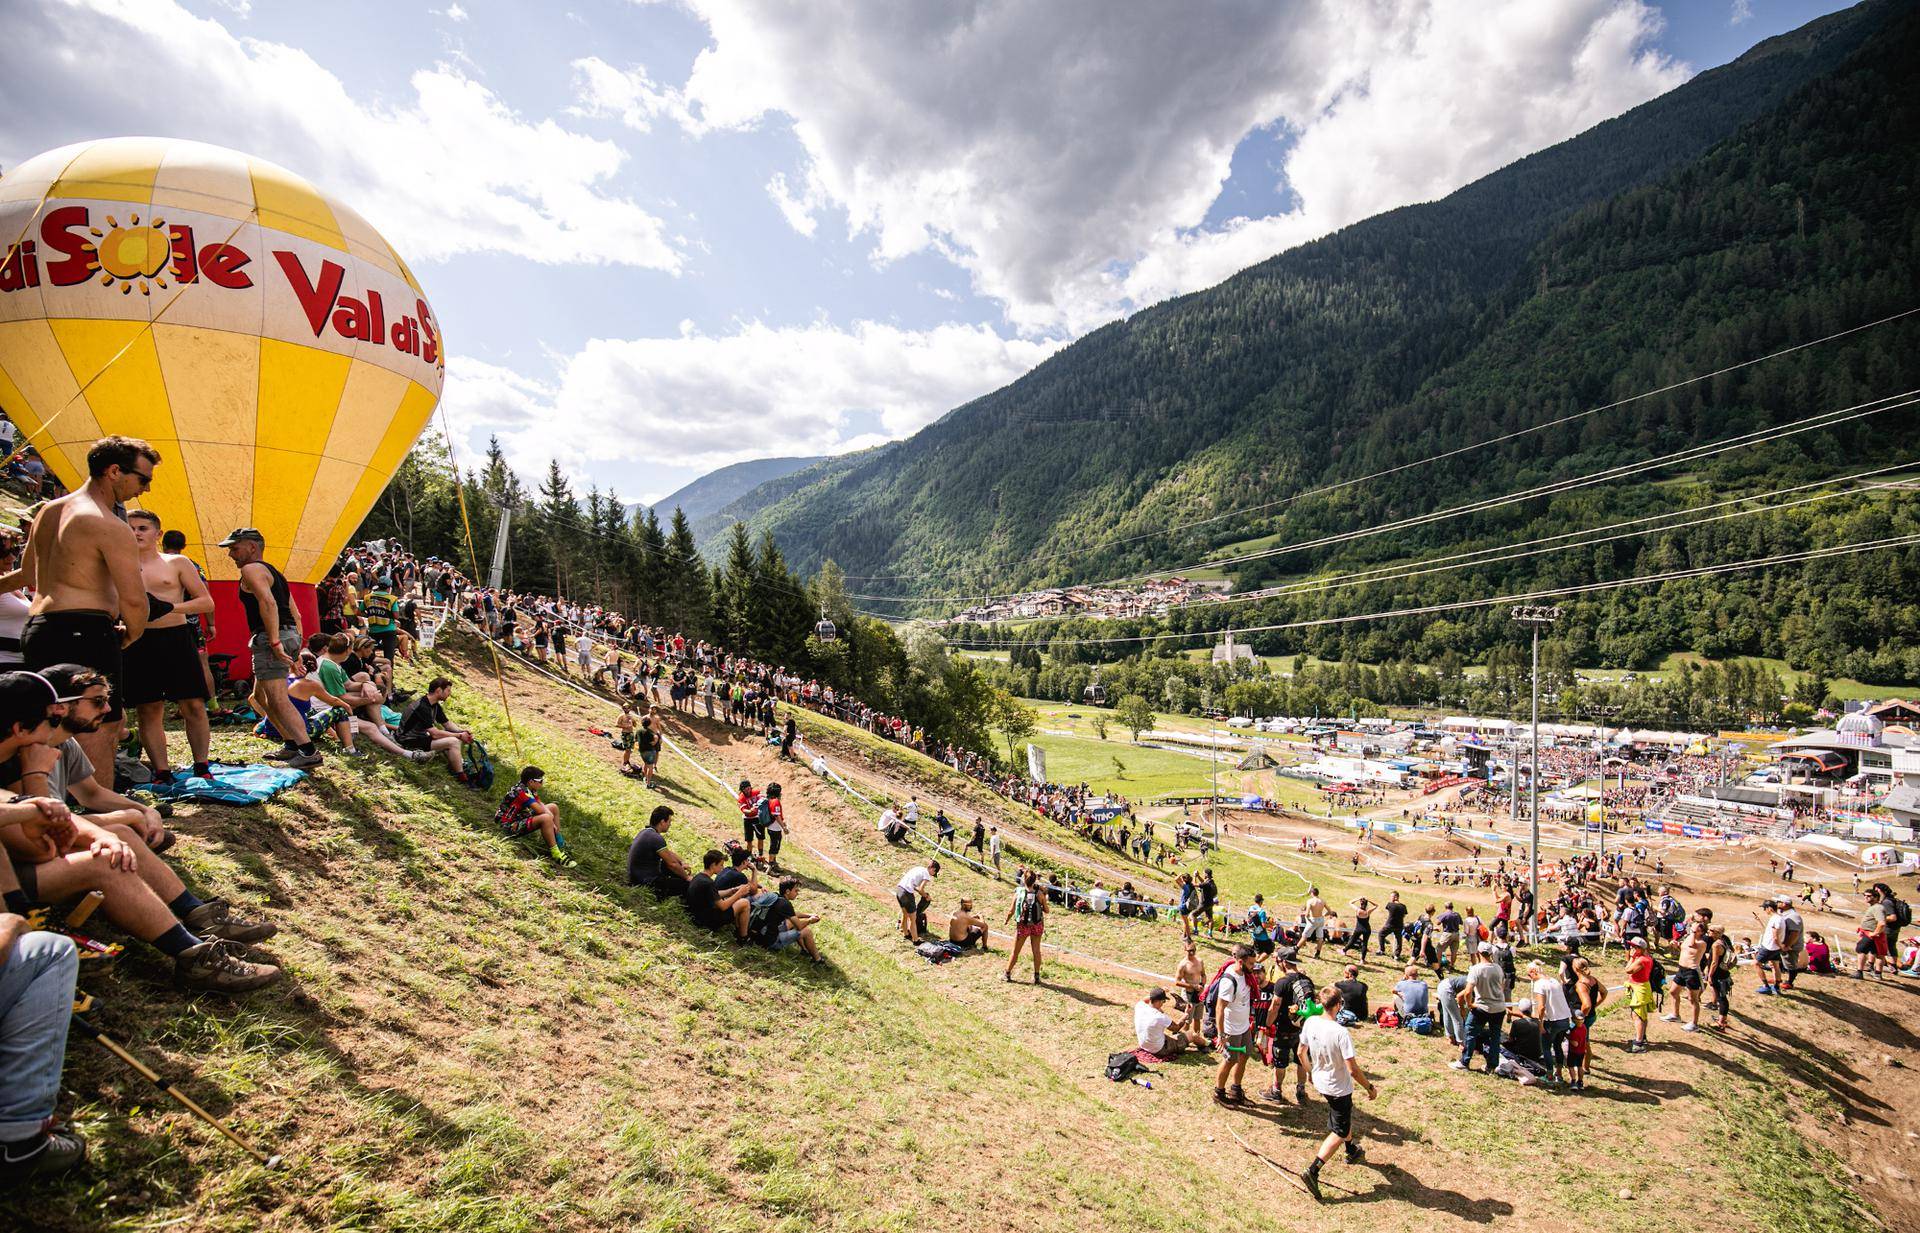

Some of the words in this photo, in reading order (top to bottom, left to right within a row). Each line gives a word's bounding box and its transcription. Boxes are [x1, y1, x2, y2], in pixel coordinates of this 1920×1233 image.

[0, 240, 41, 292] di
[272, 251, 385, 345] Val
[391, 315, 419, 356] di
